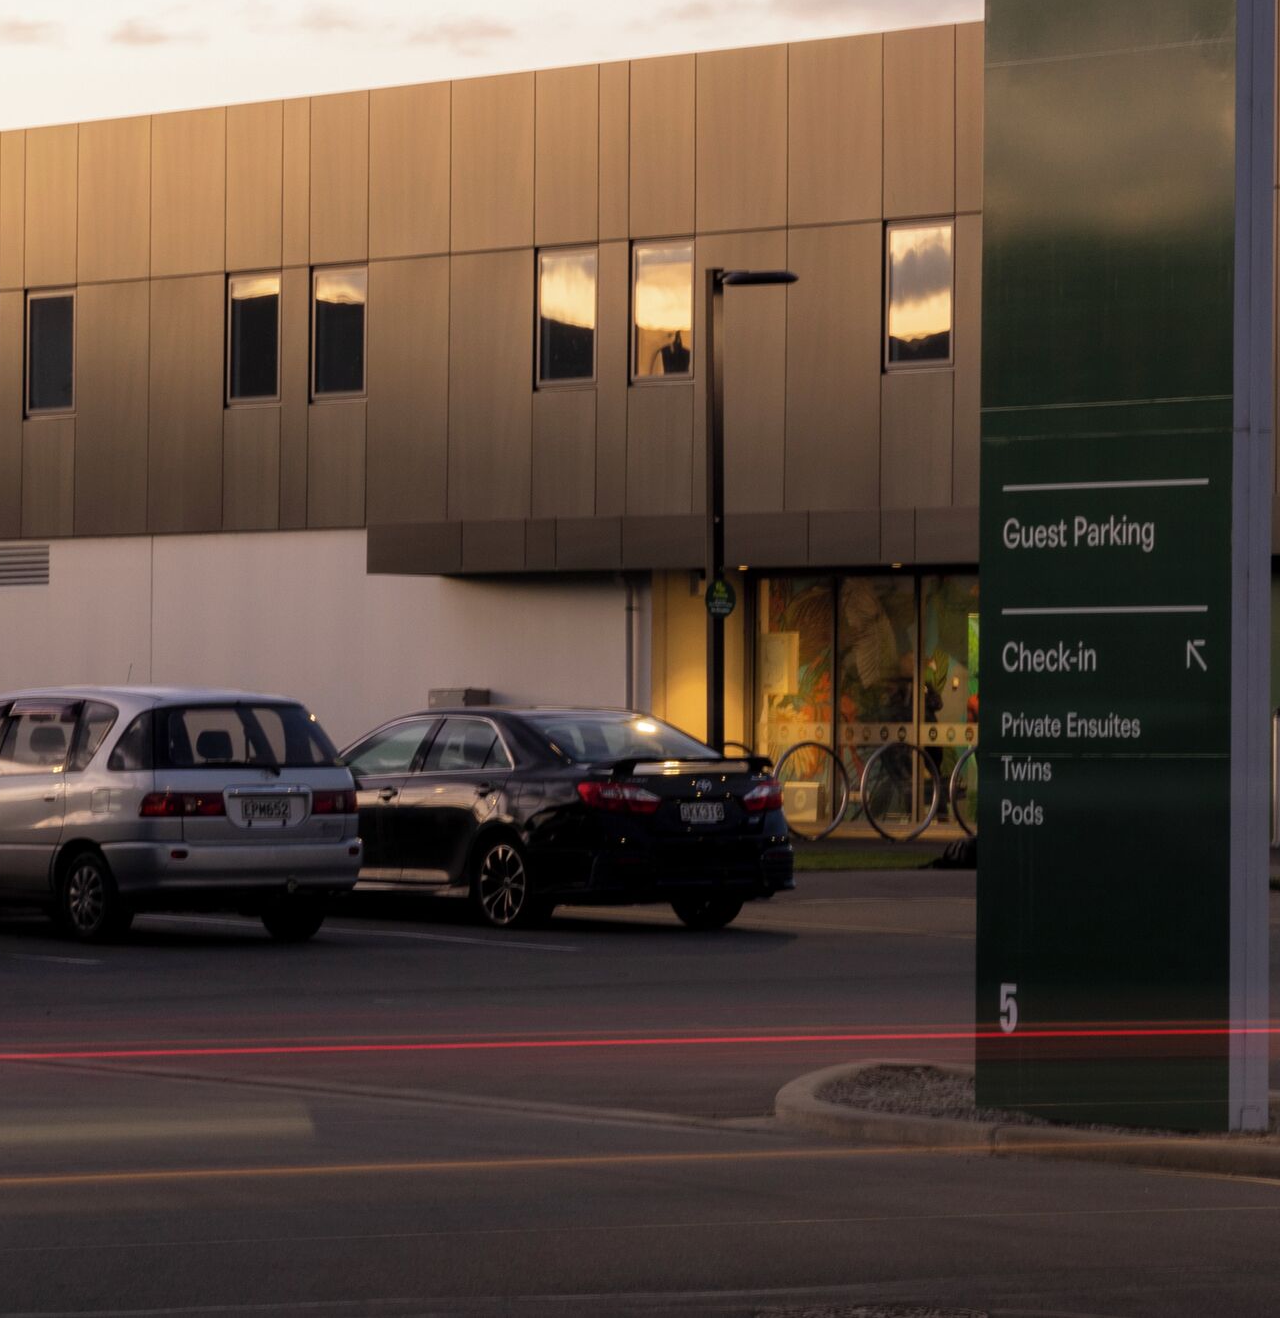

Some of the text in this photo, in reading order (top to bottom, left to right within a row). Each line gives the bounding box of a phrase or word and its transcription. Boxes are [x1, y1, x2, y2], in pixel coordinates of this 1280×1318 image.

[1002, 515, 1155, 553] Guest Parking
[1001, 641, 1097, 672] Check-in
[1001, 712, 1141, 738] Private Ensuites
[1001, 755, 1052, 782] Twins
[1001, 799, 1044, 826] Pods
[1000, 982, 1018, 1034] 5
